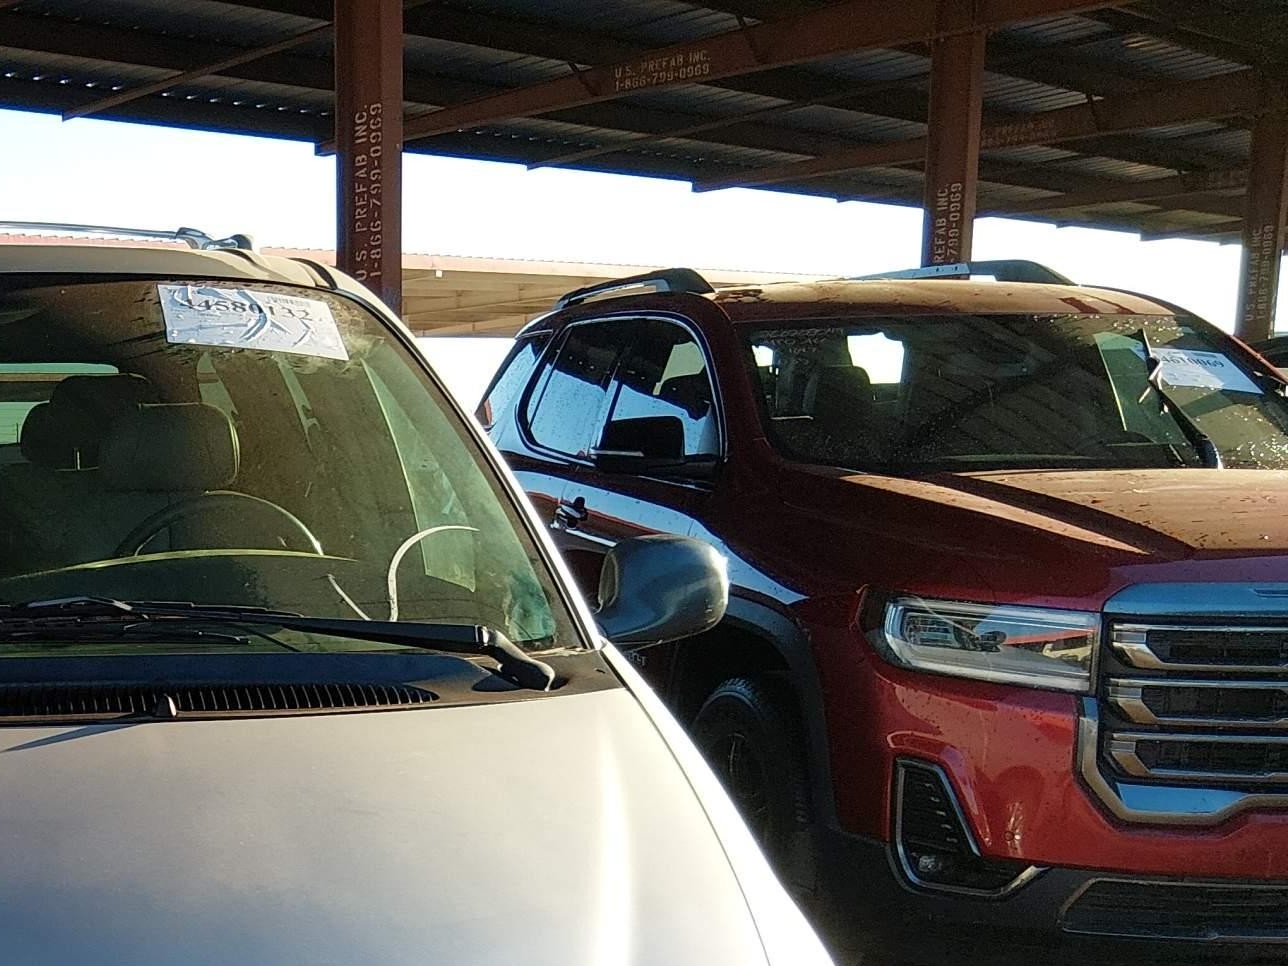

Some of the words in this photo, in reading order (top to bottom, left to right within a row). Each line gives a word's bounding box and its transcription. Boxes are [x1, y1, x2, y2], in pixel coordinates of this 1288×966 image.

[640, 54, 684, 73] PREFAB
[354, 104, 369, 144] INC.
[354, 154, 368, 233] PREFAB
[369, 103, 383, 278] 1-866-799-0969
